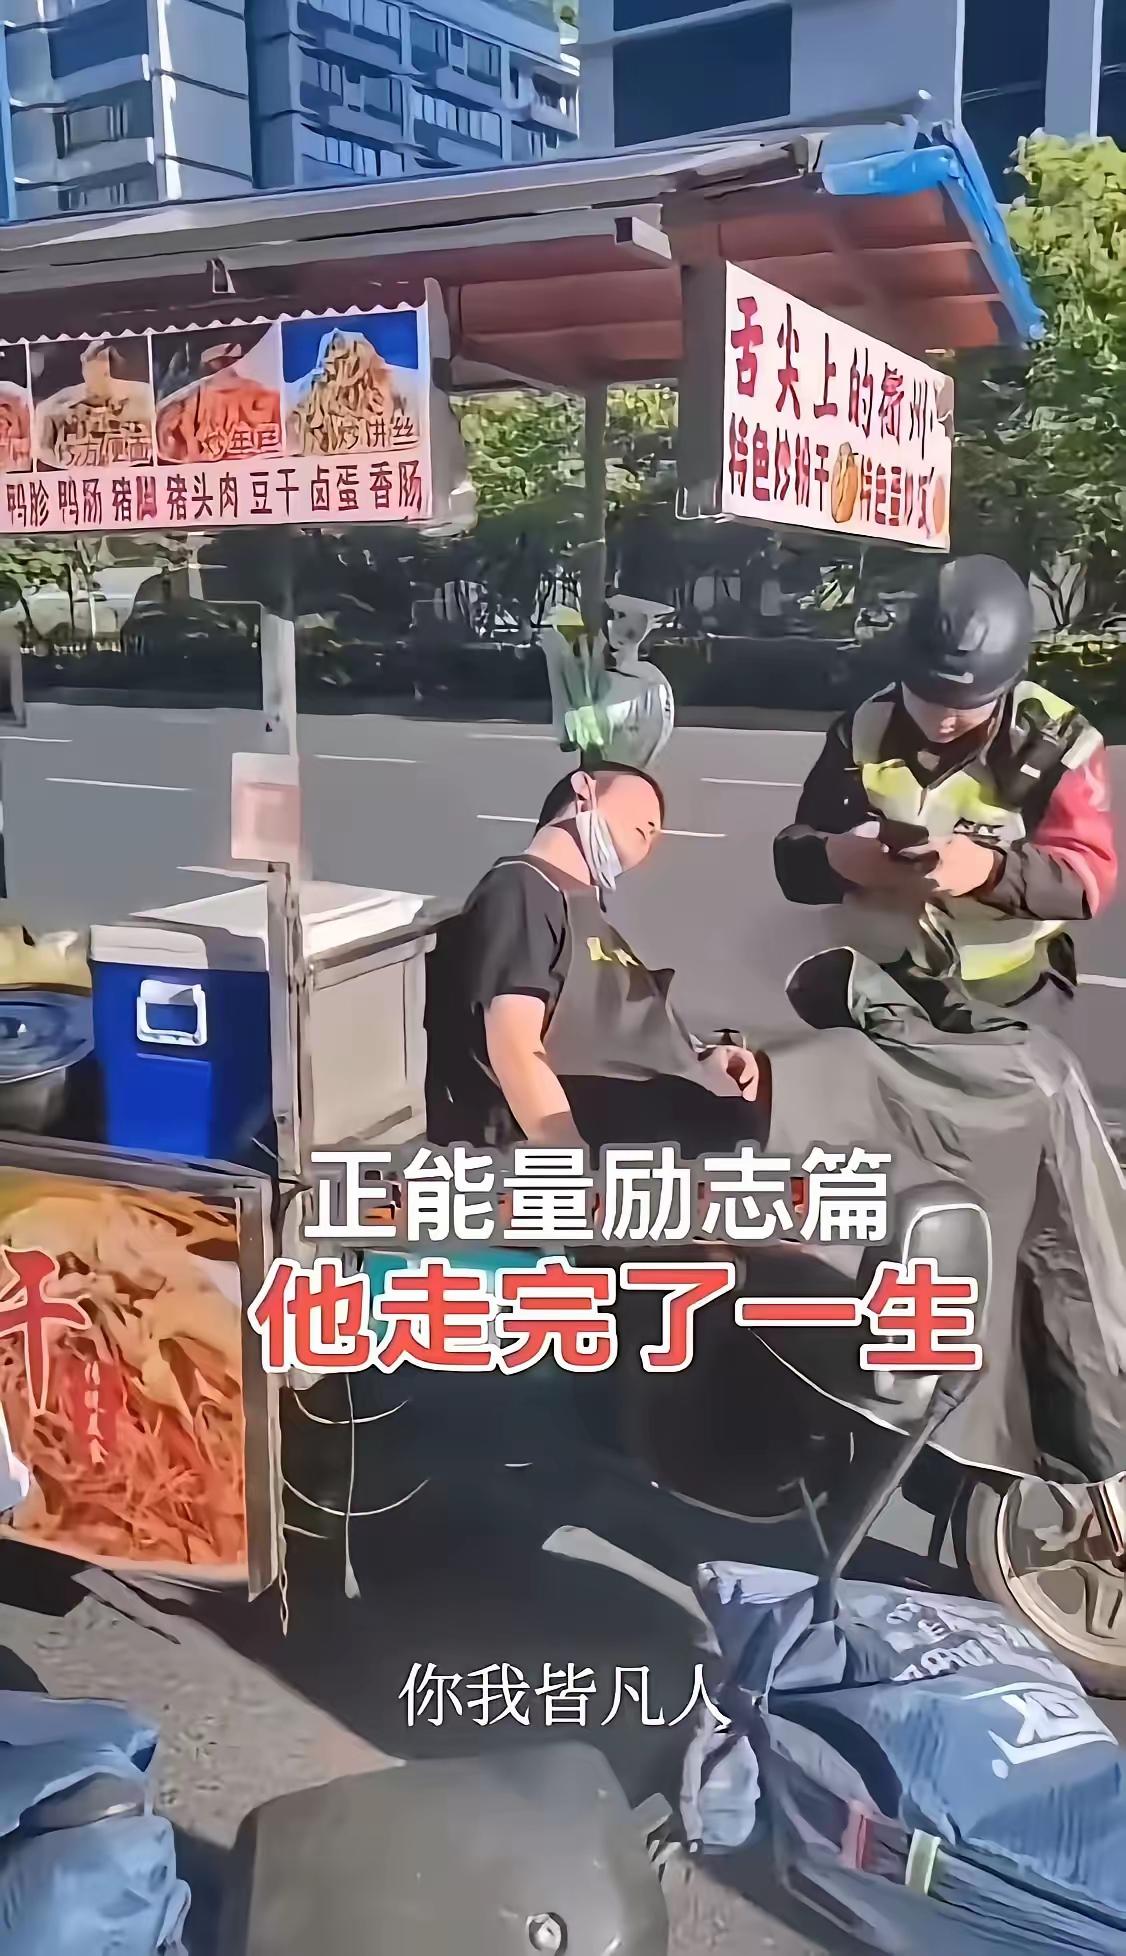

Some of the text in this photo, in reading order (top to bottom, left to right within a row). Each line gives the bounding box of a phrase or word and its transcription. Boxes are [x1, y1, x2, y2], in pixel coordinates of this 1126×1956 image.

[166, 471, 239, 521] 猪头肉
[249, 468, 300, 516] 豆干
[310, 464, 360, 512] 卤蛋
[368, 459, 423, 512] 香肠
